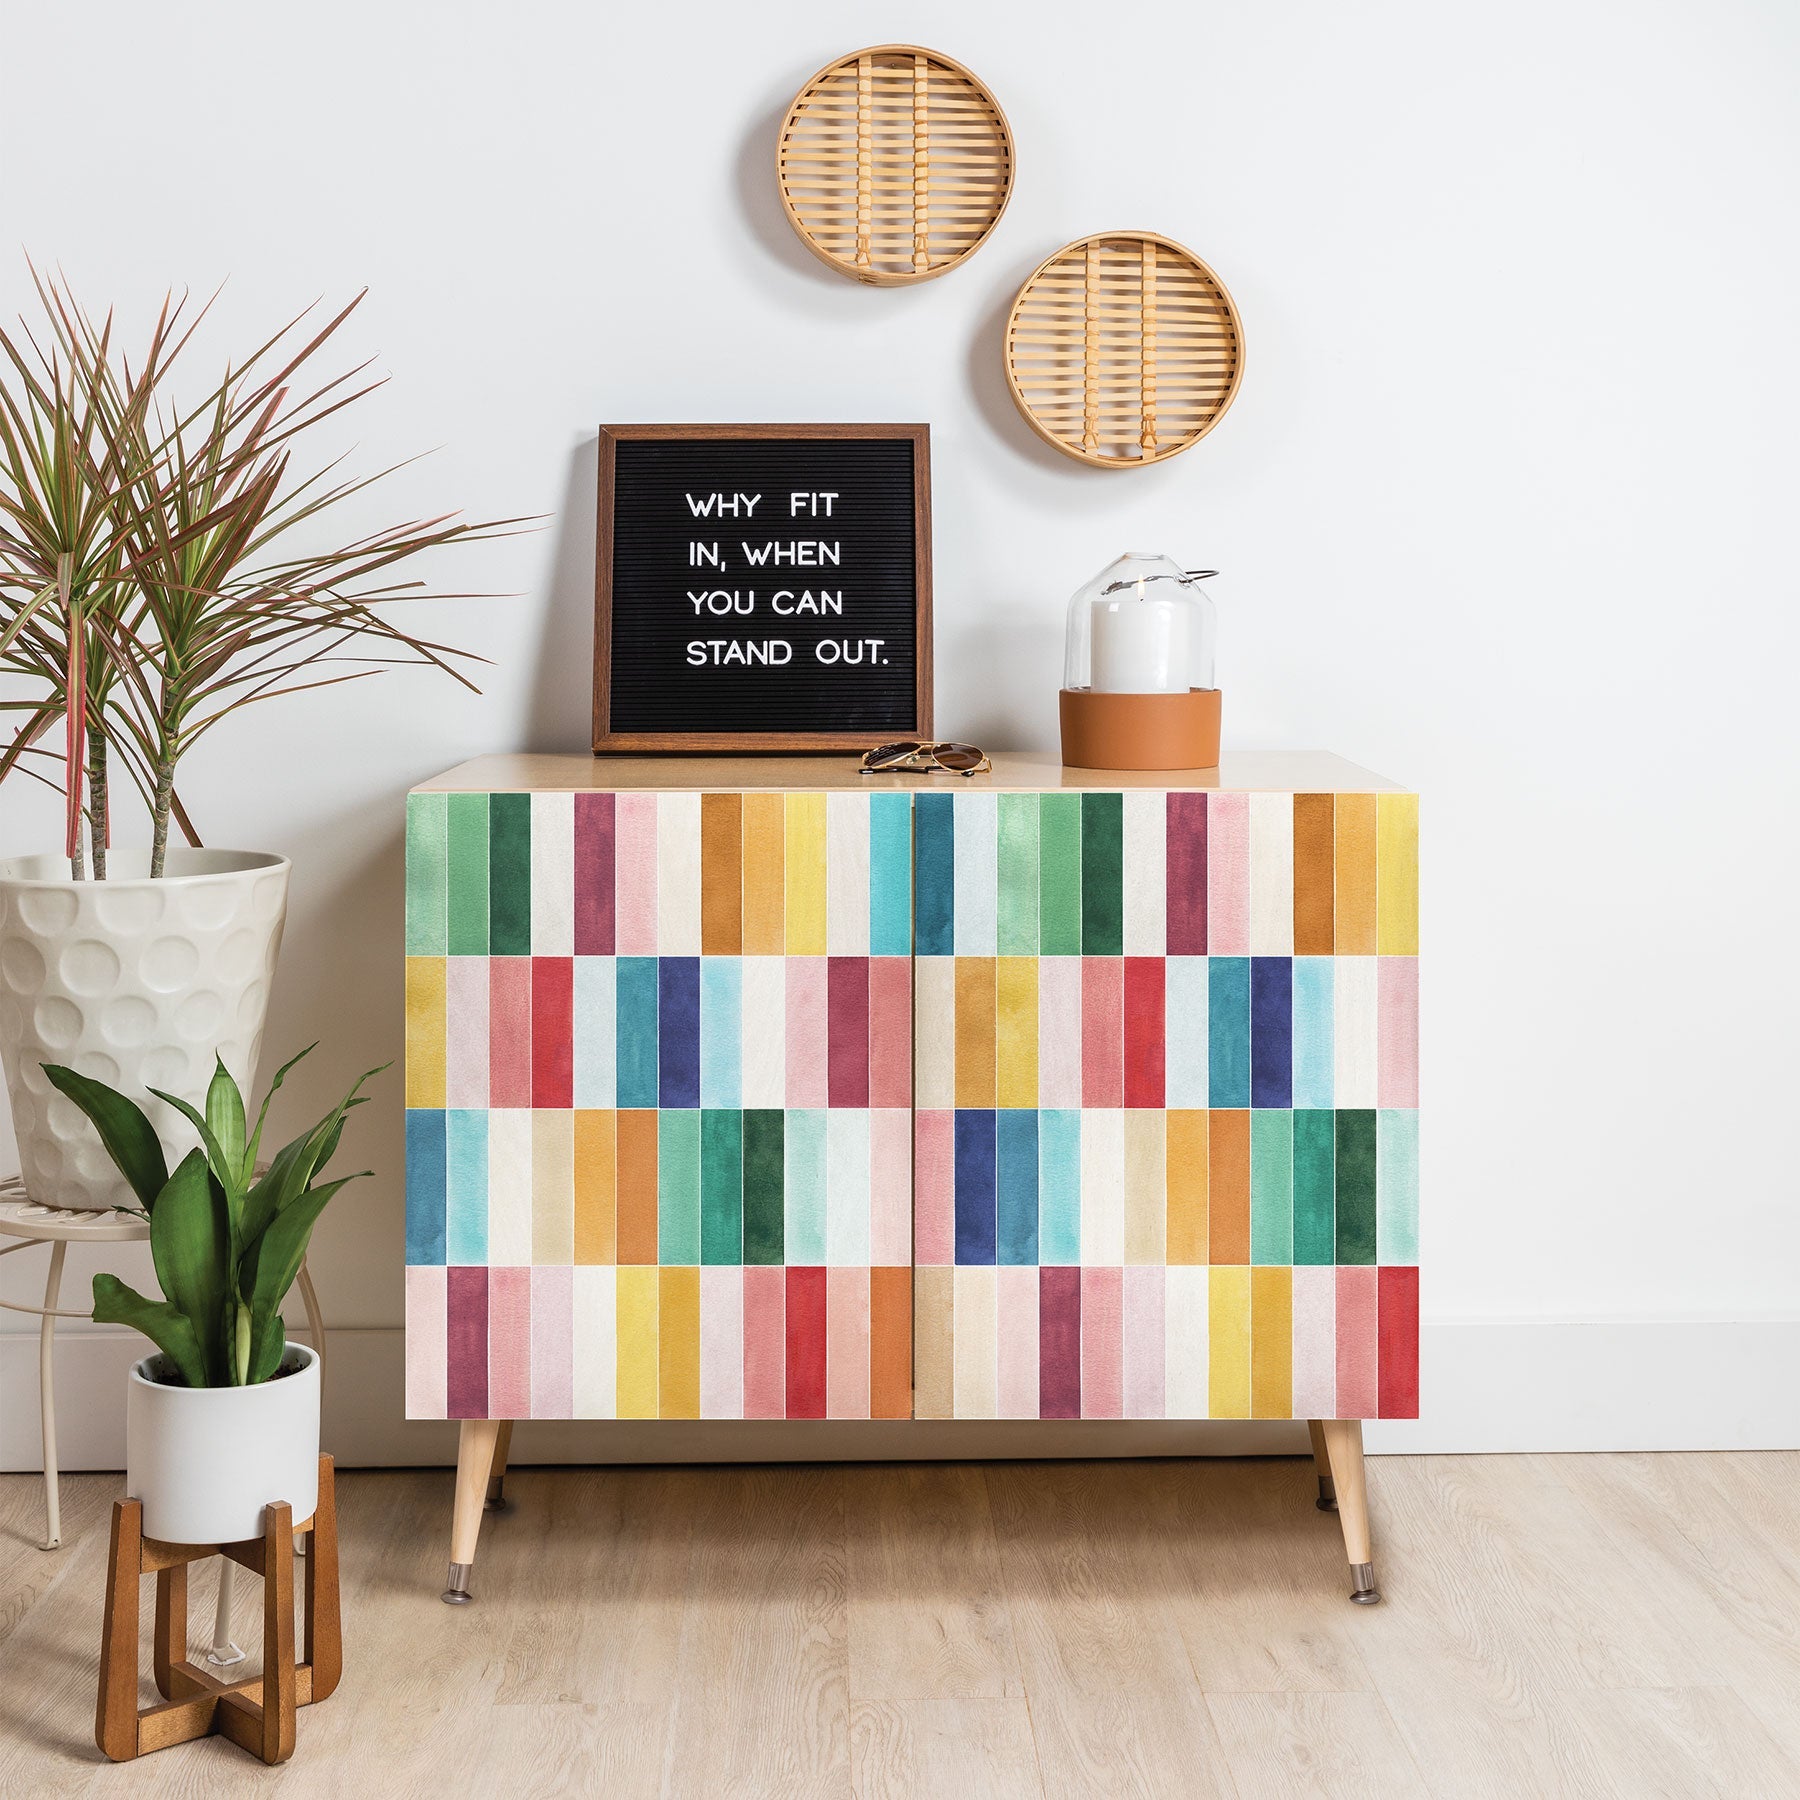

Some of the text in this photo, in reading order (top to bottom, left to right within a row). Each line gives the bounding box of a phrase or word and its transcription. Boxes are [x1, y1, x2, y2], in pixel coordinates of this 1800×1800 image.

[686, 492, 840, 518] WHY FIT
[689, 541, 840, 573] IN, WHEN
[686, 590, 843, 616] YOU CAN
[686, 640, 889, 666] STAND OUT.
